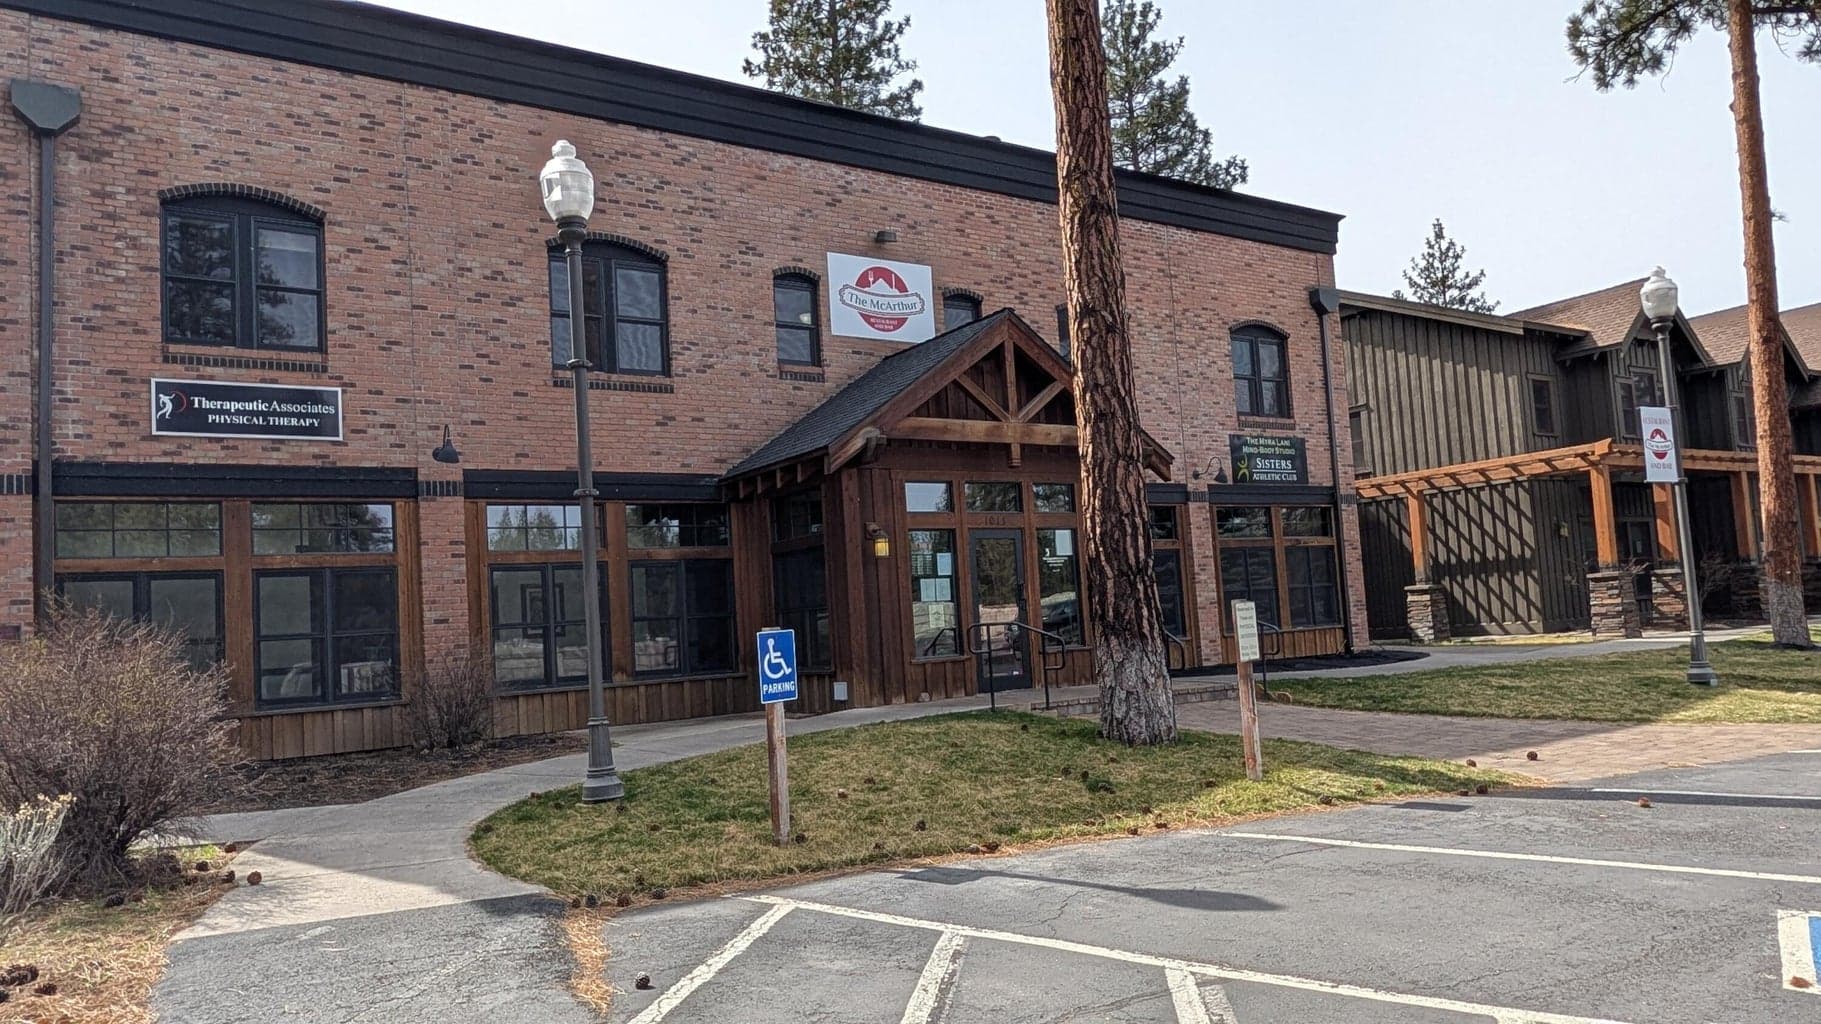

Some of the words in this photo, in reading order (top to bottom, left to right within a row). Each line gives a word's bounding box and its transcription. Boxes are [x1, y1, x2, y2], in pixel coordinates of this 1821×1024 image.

[848, 292, 868, 306] The
[870, 299, 917, 312] McArthur
[190, 396, 269, 412] Therapeutic
[270, 401, 336, 414] Associates
[207, 414, 266, 425] PHYSICAL
[267, 416, 321, 427] THERAPY
[1256, 457, 1292, 470] SISTERS
[1252, 473, 1281, 481] ATHLETIC
[1282, 473, 1298, 482] CLUB
[762, 680, 795, 695] PARKING
